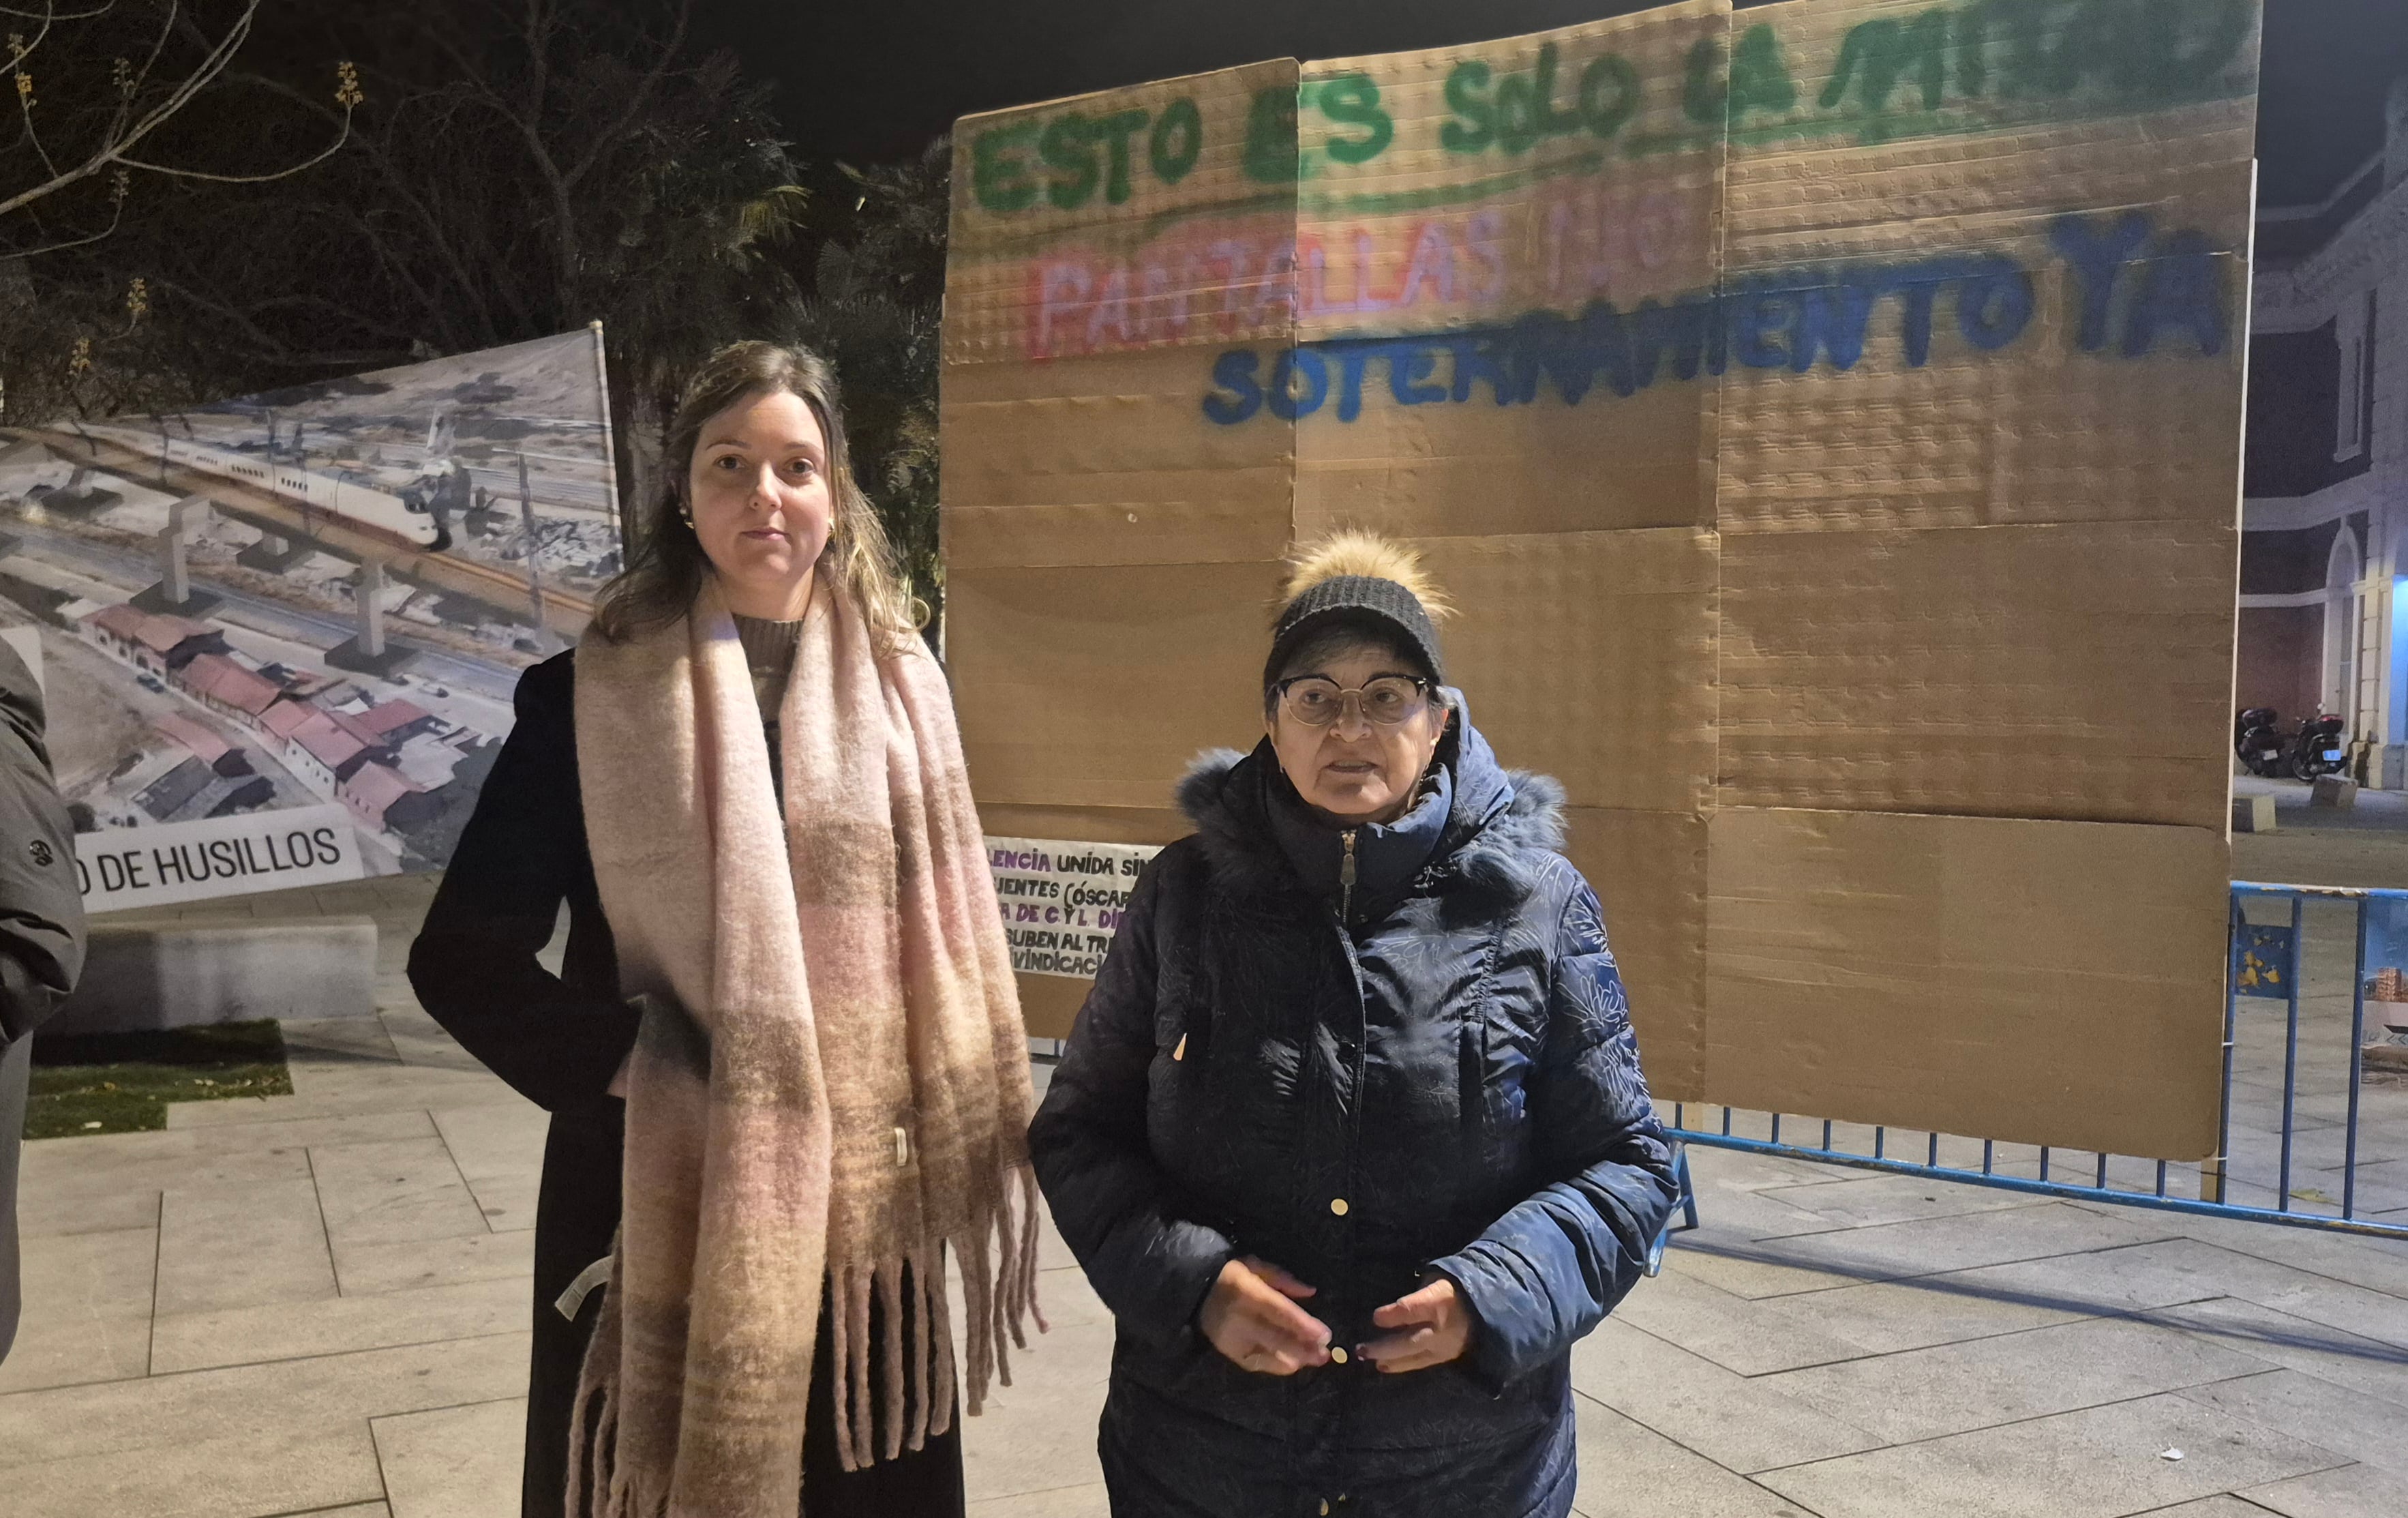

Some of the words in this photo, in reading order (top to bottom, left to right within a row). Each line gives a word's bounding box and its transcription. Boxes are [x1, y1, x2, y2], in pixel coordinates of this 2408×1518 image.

[972, 96, 1203, 210] ESTO
[1241, 73, 1395, 184] ES
[1439, 40, 1636, 155] SOLO
[1684, 22, 1796, 124] LA
[1026, 210, 1505, 363] PANTALLAS
[2051, 211, 2231, 358] YA
[97, 850, 150, 891] DE
[153, 828, 341, 884] HUSILLOS
[1016, 904, 1040, 922] DE
[1064, 907, 1075, 924] Y
[1098, 908, 1125, 929] DI
[1061, 933, 1083, 951] AL
[1087, 935, 1114, 954] TR
